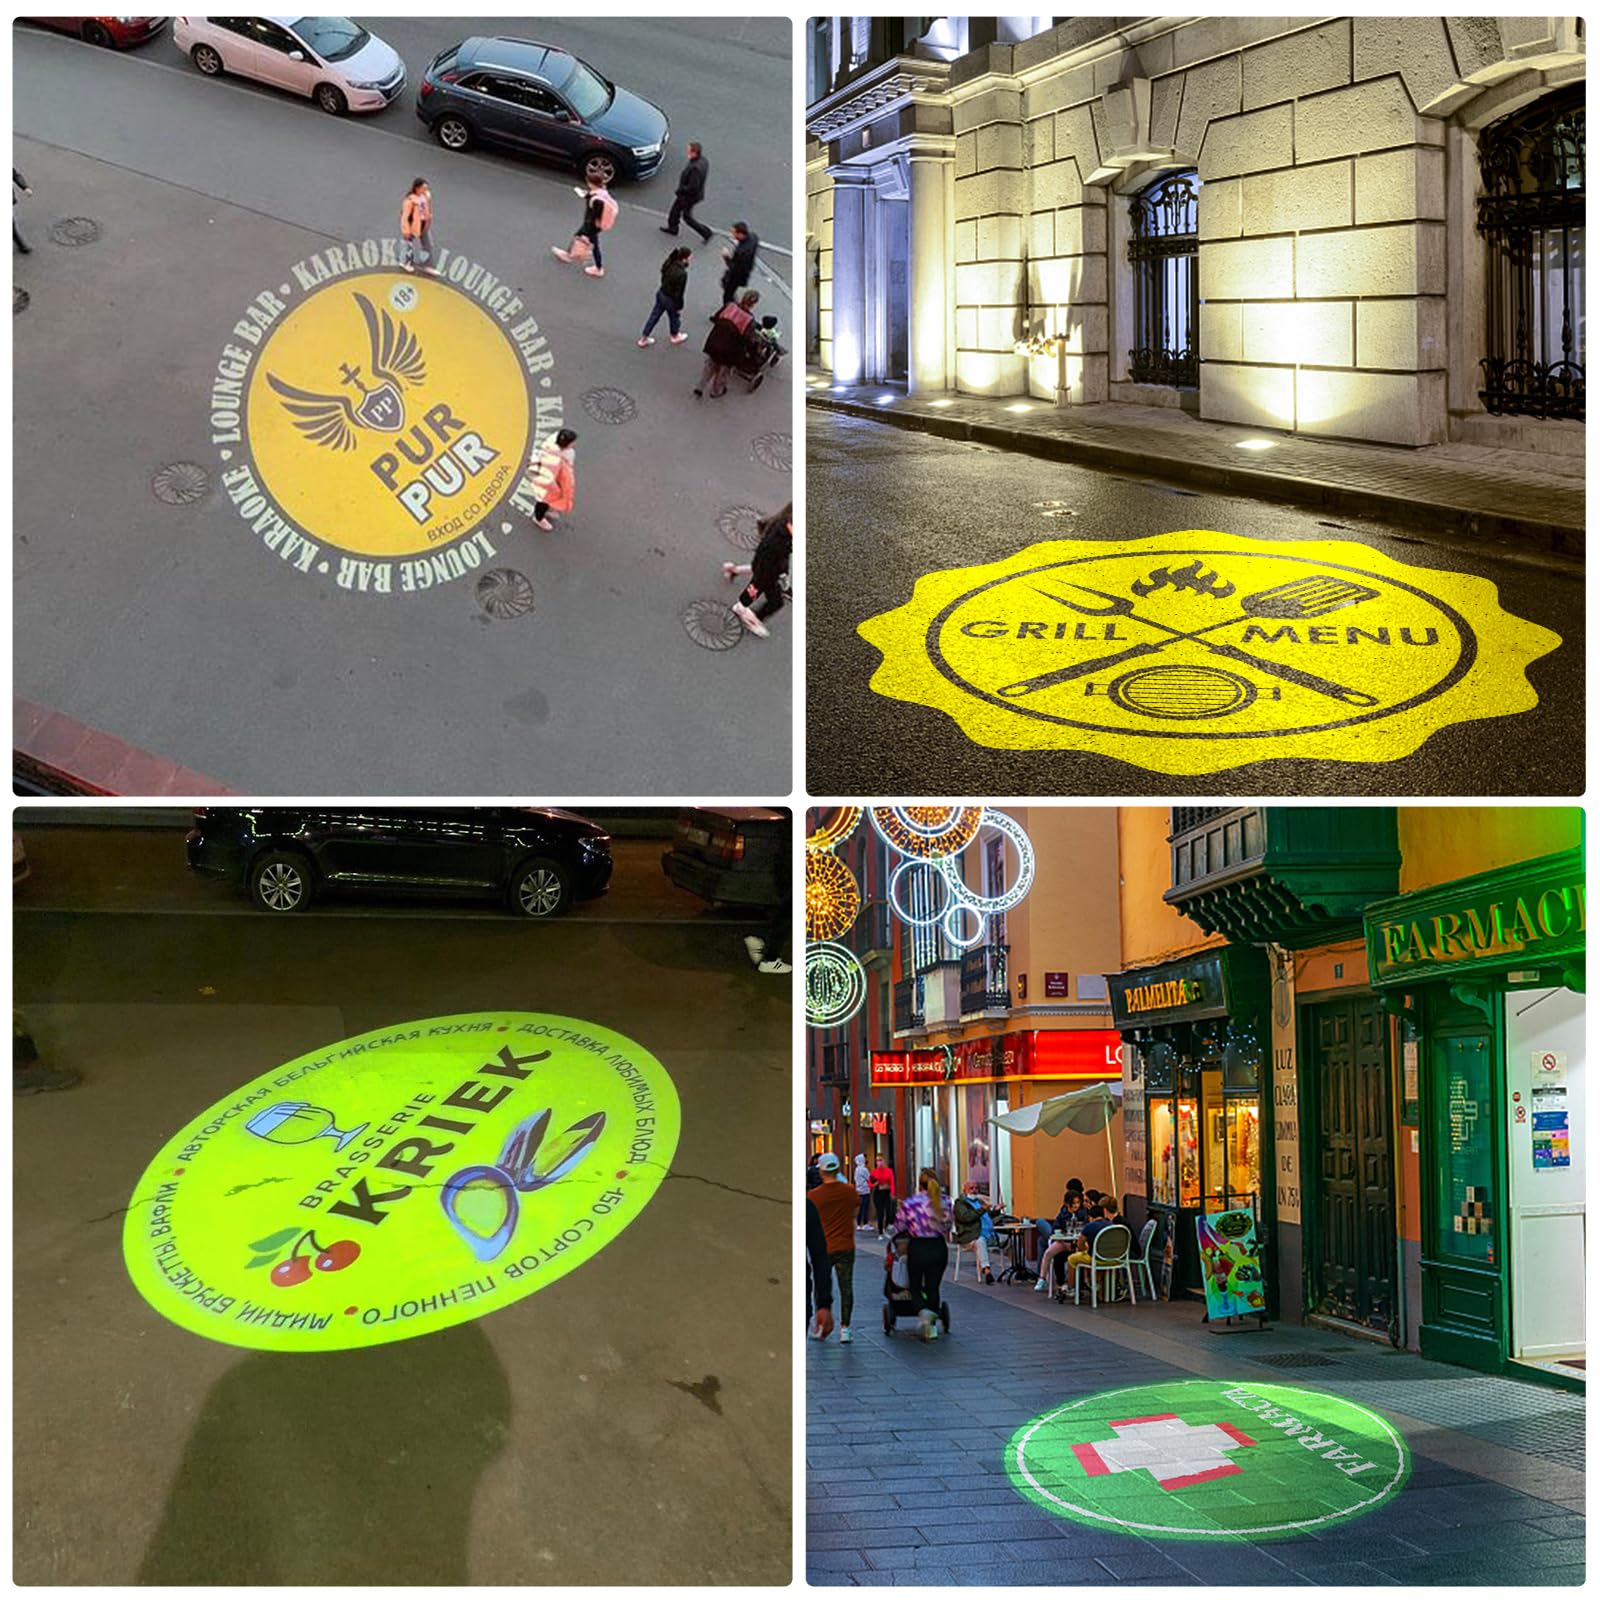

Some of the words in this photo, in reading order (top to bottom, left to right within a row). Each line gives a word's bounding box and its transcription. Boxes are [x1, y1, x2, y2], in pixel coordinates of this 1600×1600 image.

[393, 286, 416, 308] 18+
[436, 248, 524, 323] LOUNGE
[510, 316, 557, 379] BAR
[210, 343, 254, 445] LOUNGE
[233, 289, 287, 345] BAR
[370, 403, 467, 491] PUR
[396, 431, 501, 525] PUR
[426, 514, 464, 542] ВХОД
[463, 502, 482, 523] СО
[481, 463, 512, 508] ДВОРА
[221, 465, 320, 574] KARAOKE
[336, 557, 392, 594] BAR
[402, 530, 498, 592] LOUNGE
[959, 619, 1129, 643] GRILL
[1241, 624, 1440, 648] MENU
[1124, 977, 1188, 1014] PALMELITA
[516, 1022, 610, 1056] ДОСТАВКА
[1275, 1047, 1293, 1070] LUZ
[177, 1086, 271, 1163] АВТОРСКАЯ
[274, 1028, 421, 1088] БЕЛЬГИЙСКАЯ
[428, 1021, 493, 1039] КУХНЯ
[608, 1051, 653, 1112] ЛЮБИМЫХ
[299, 1091, 437, 1210] BRASSERIE
[327, 1044, 552, 1227] KRIEK
[627, 1113, 656, 1165] БЛЮД
[1282, 1155, 1294, 1172] DE
[149, 1181, 179, 1239] ВАФЛИ
[592, 1187, 625, 1216] 150
[155, 1236, 236, 1316] БРУСКЕТТЫ,
[503, 1220, 593, 1281] СОРТОВ
[241, 1299, 333, 1331] МИДИИ,
[362, 1277, 497, 1326] ПЕННОГО
[1220, 1387, 1379, 1477] FARMACIA
